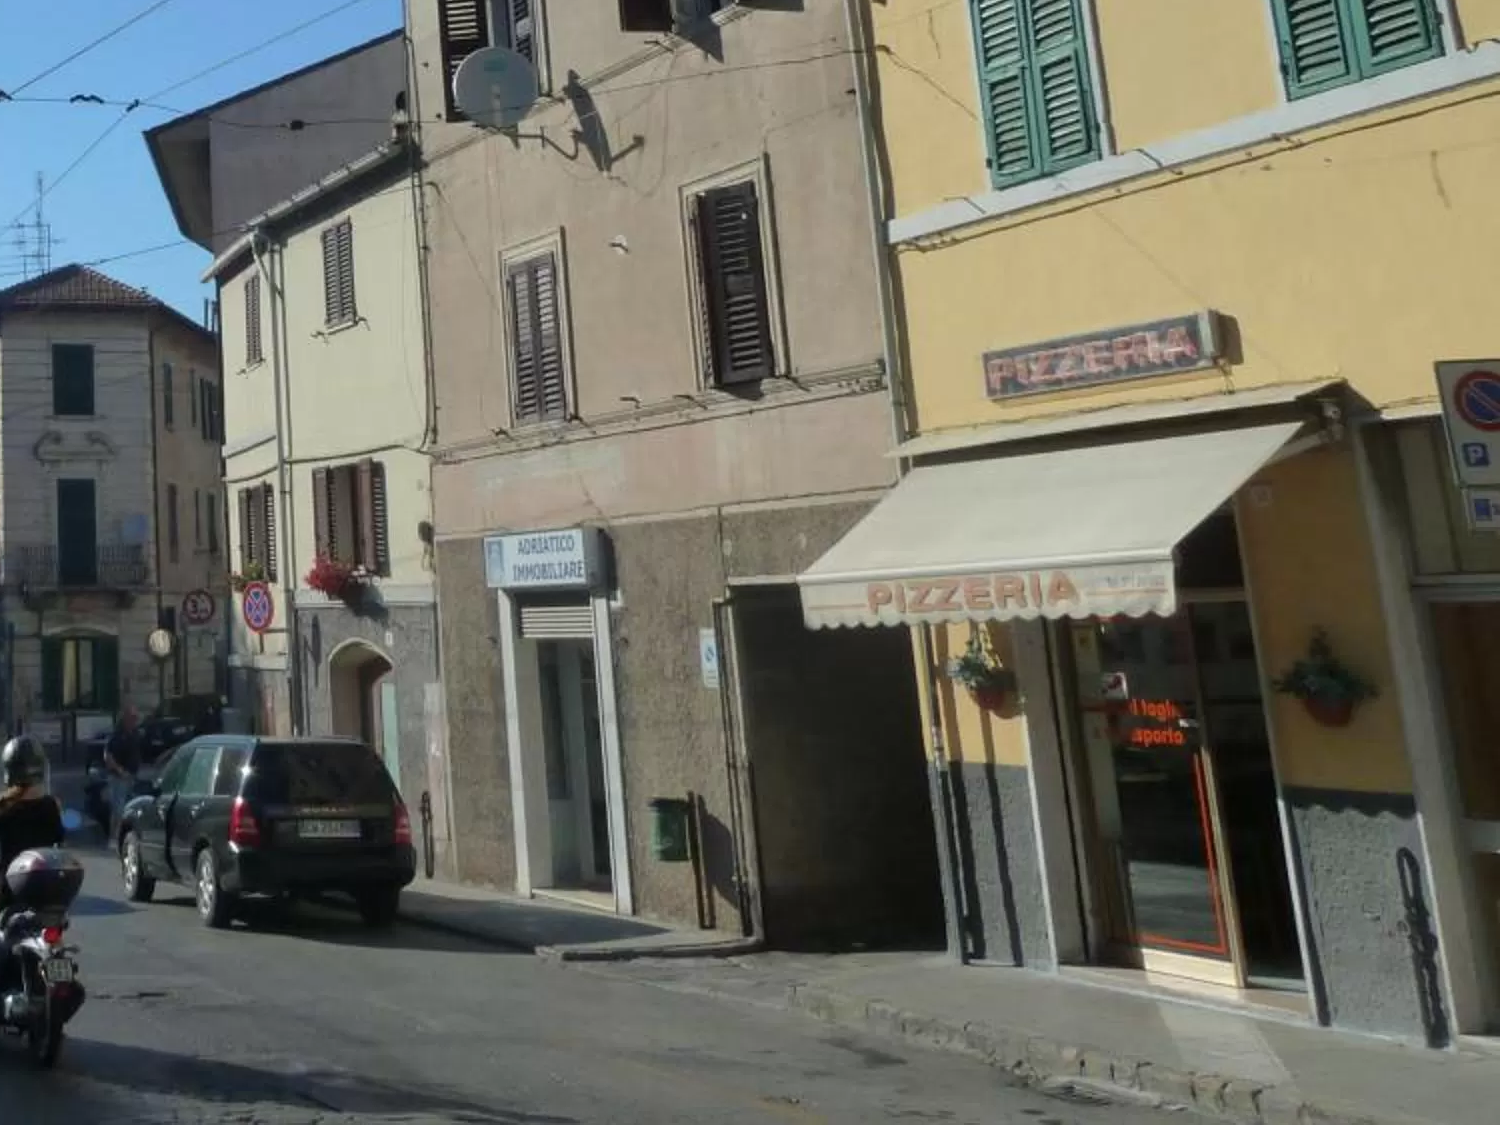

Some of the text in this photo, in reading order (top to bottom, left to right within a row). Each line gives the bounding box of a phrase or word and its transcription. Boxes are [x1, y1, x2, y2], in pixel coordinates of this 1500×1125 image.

[987, 325, 1199, 392] PIZZERIA
[517, 534, 576, 556] ADRIATICO
[512, 560, 585, 582] IMMOBILIARE
[867, 570, 1081, 616] PIZZERIA
